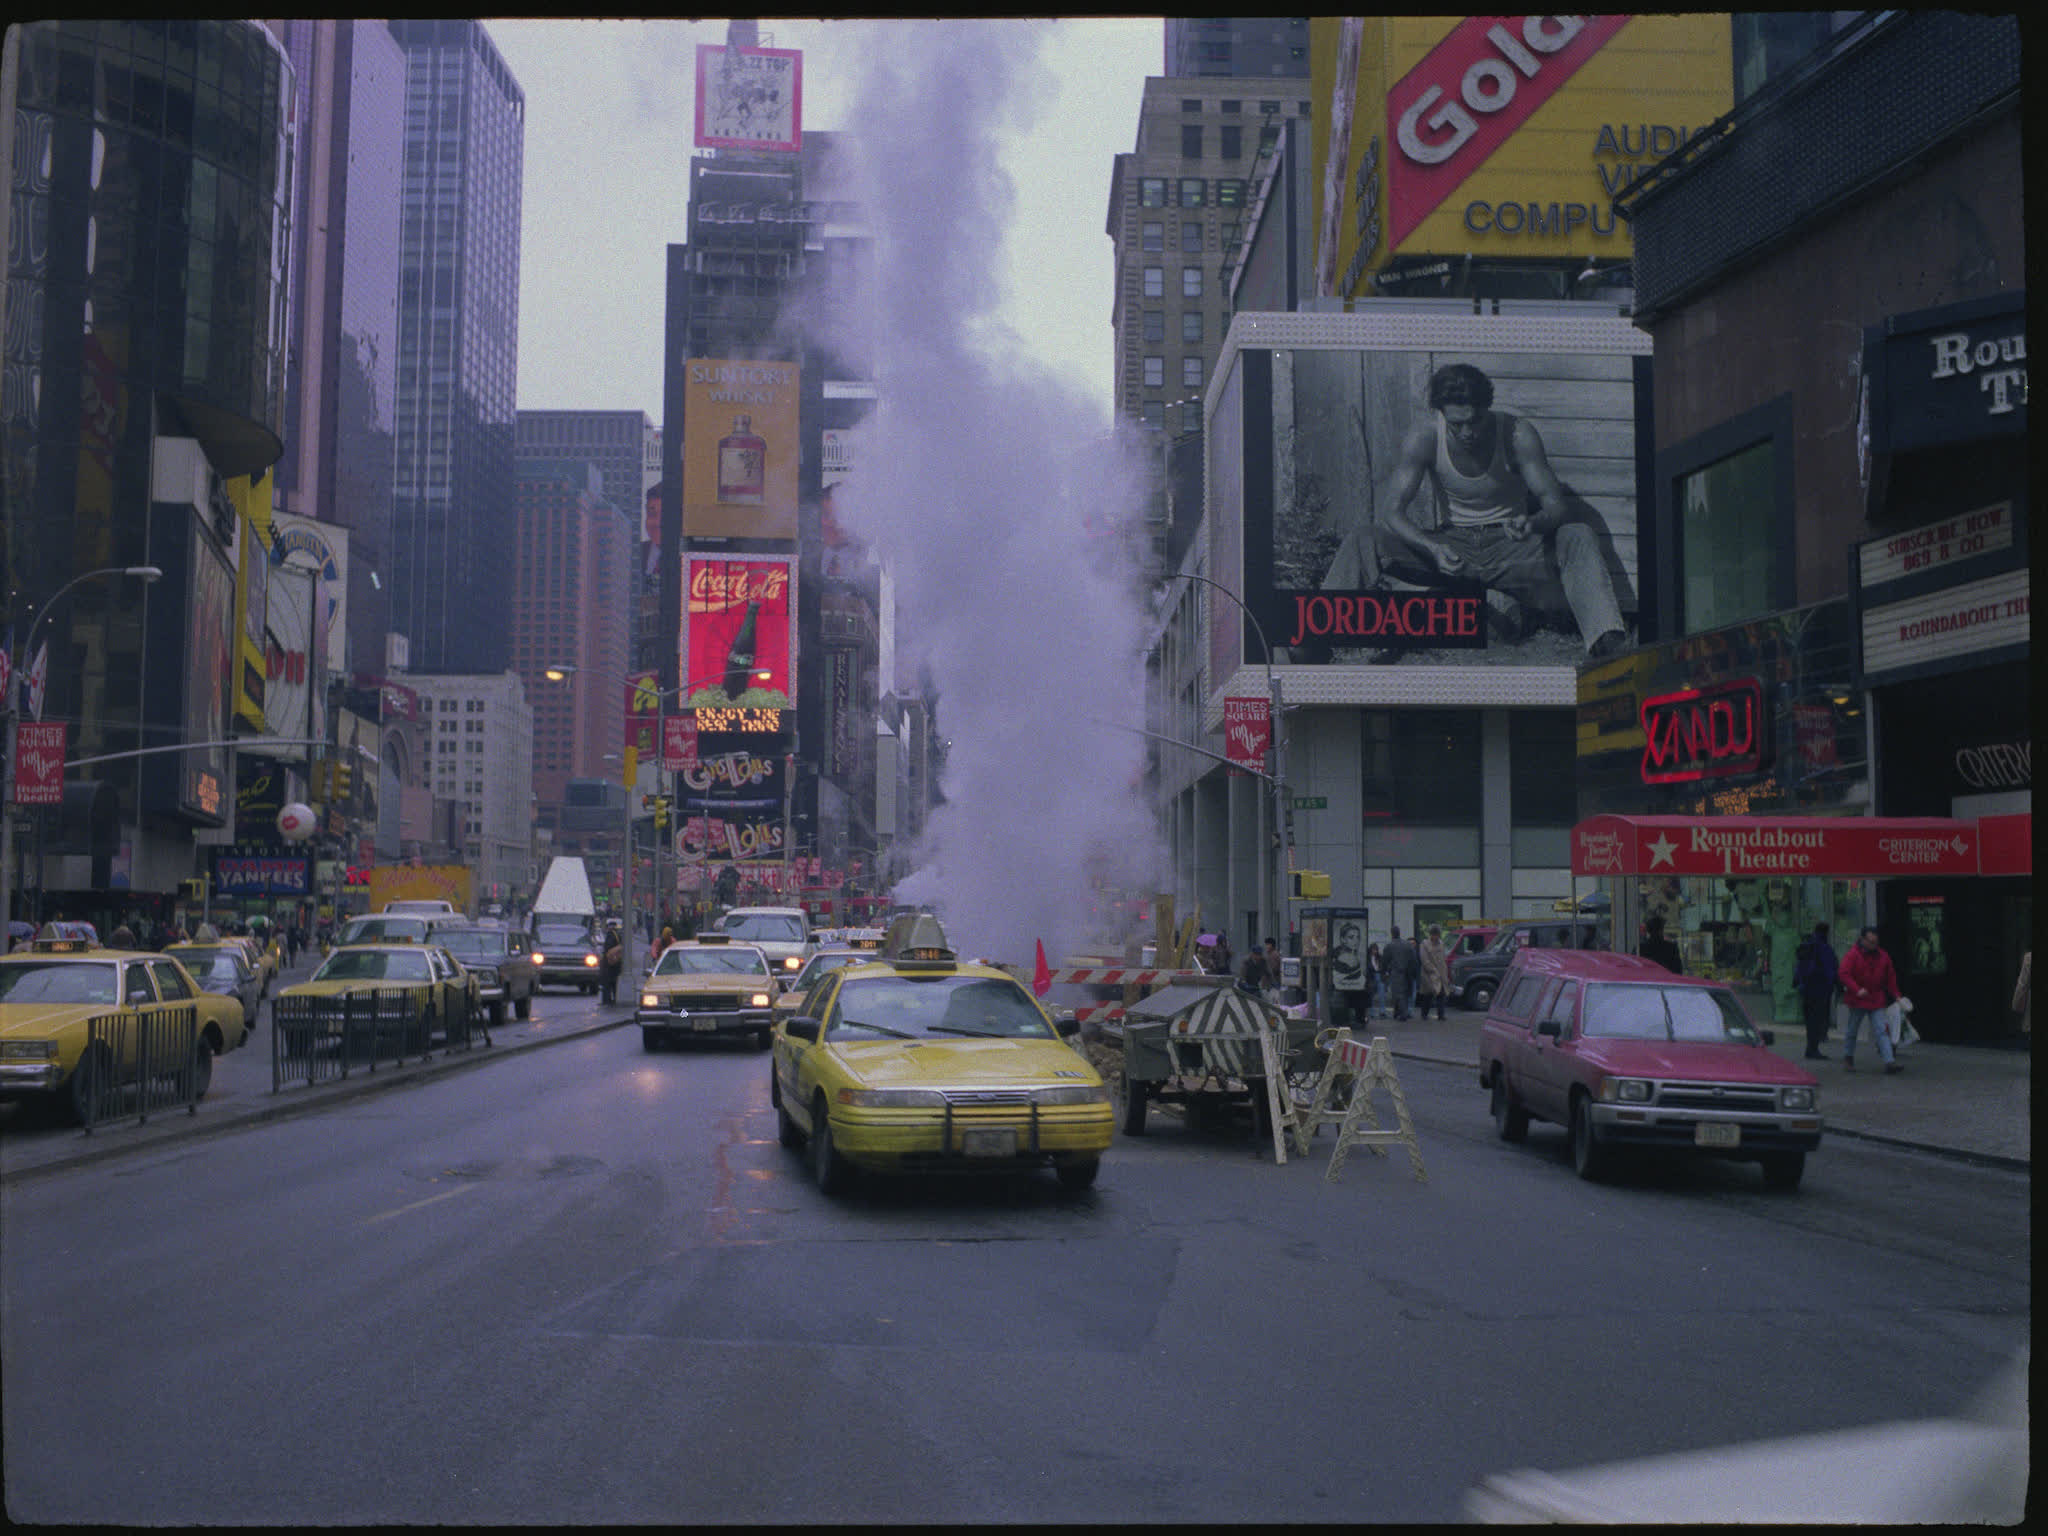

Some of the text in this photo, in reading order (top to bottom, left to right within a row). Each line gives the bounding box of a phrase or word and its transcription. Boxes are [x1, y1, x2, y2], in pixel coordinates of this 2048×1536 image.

[691, 365, 793, 385] SUNTORY
[1291, 596, 1480, 646] JORDACHE
[1900, 605, 1998, 641] ROUNDABOUT
[696, 707, 781, 720] ENJOY THE
[1226, 702, 1268, 713] TIMES
[1226, 713, 1267, 723] SQUARE
[21, 727, 63, 739] TIMES
[19, 737, 62, 748] SQUARE
[1689, 826, 1826, 853] Roundabout
[1878, 837, 1950, 852] CRITERION
[1716, 846, 1811, 875] Theatre
[1888, 851, 1941, 865] CENTER
[219, 859, 306, 873] DAMN
[218, 871, 306, 888] YANKEES
